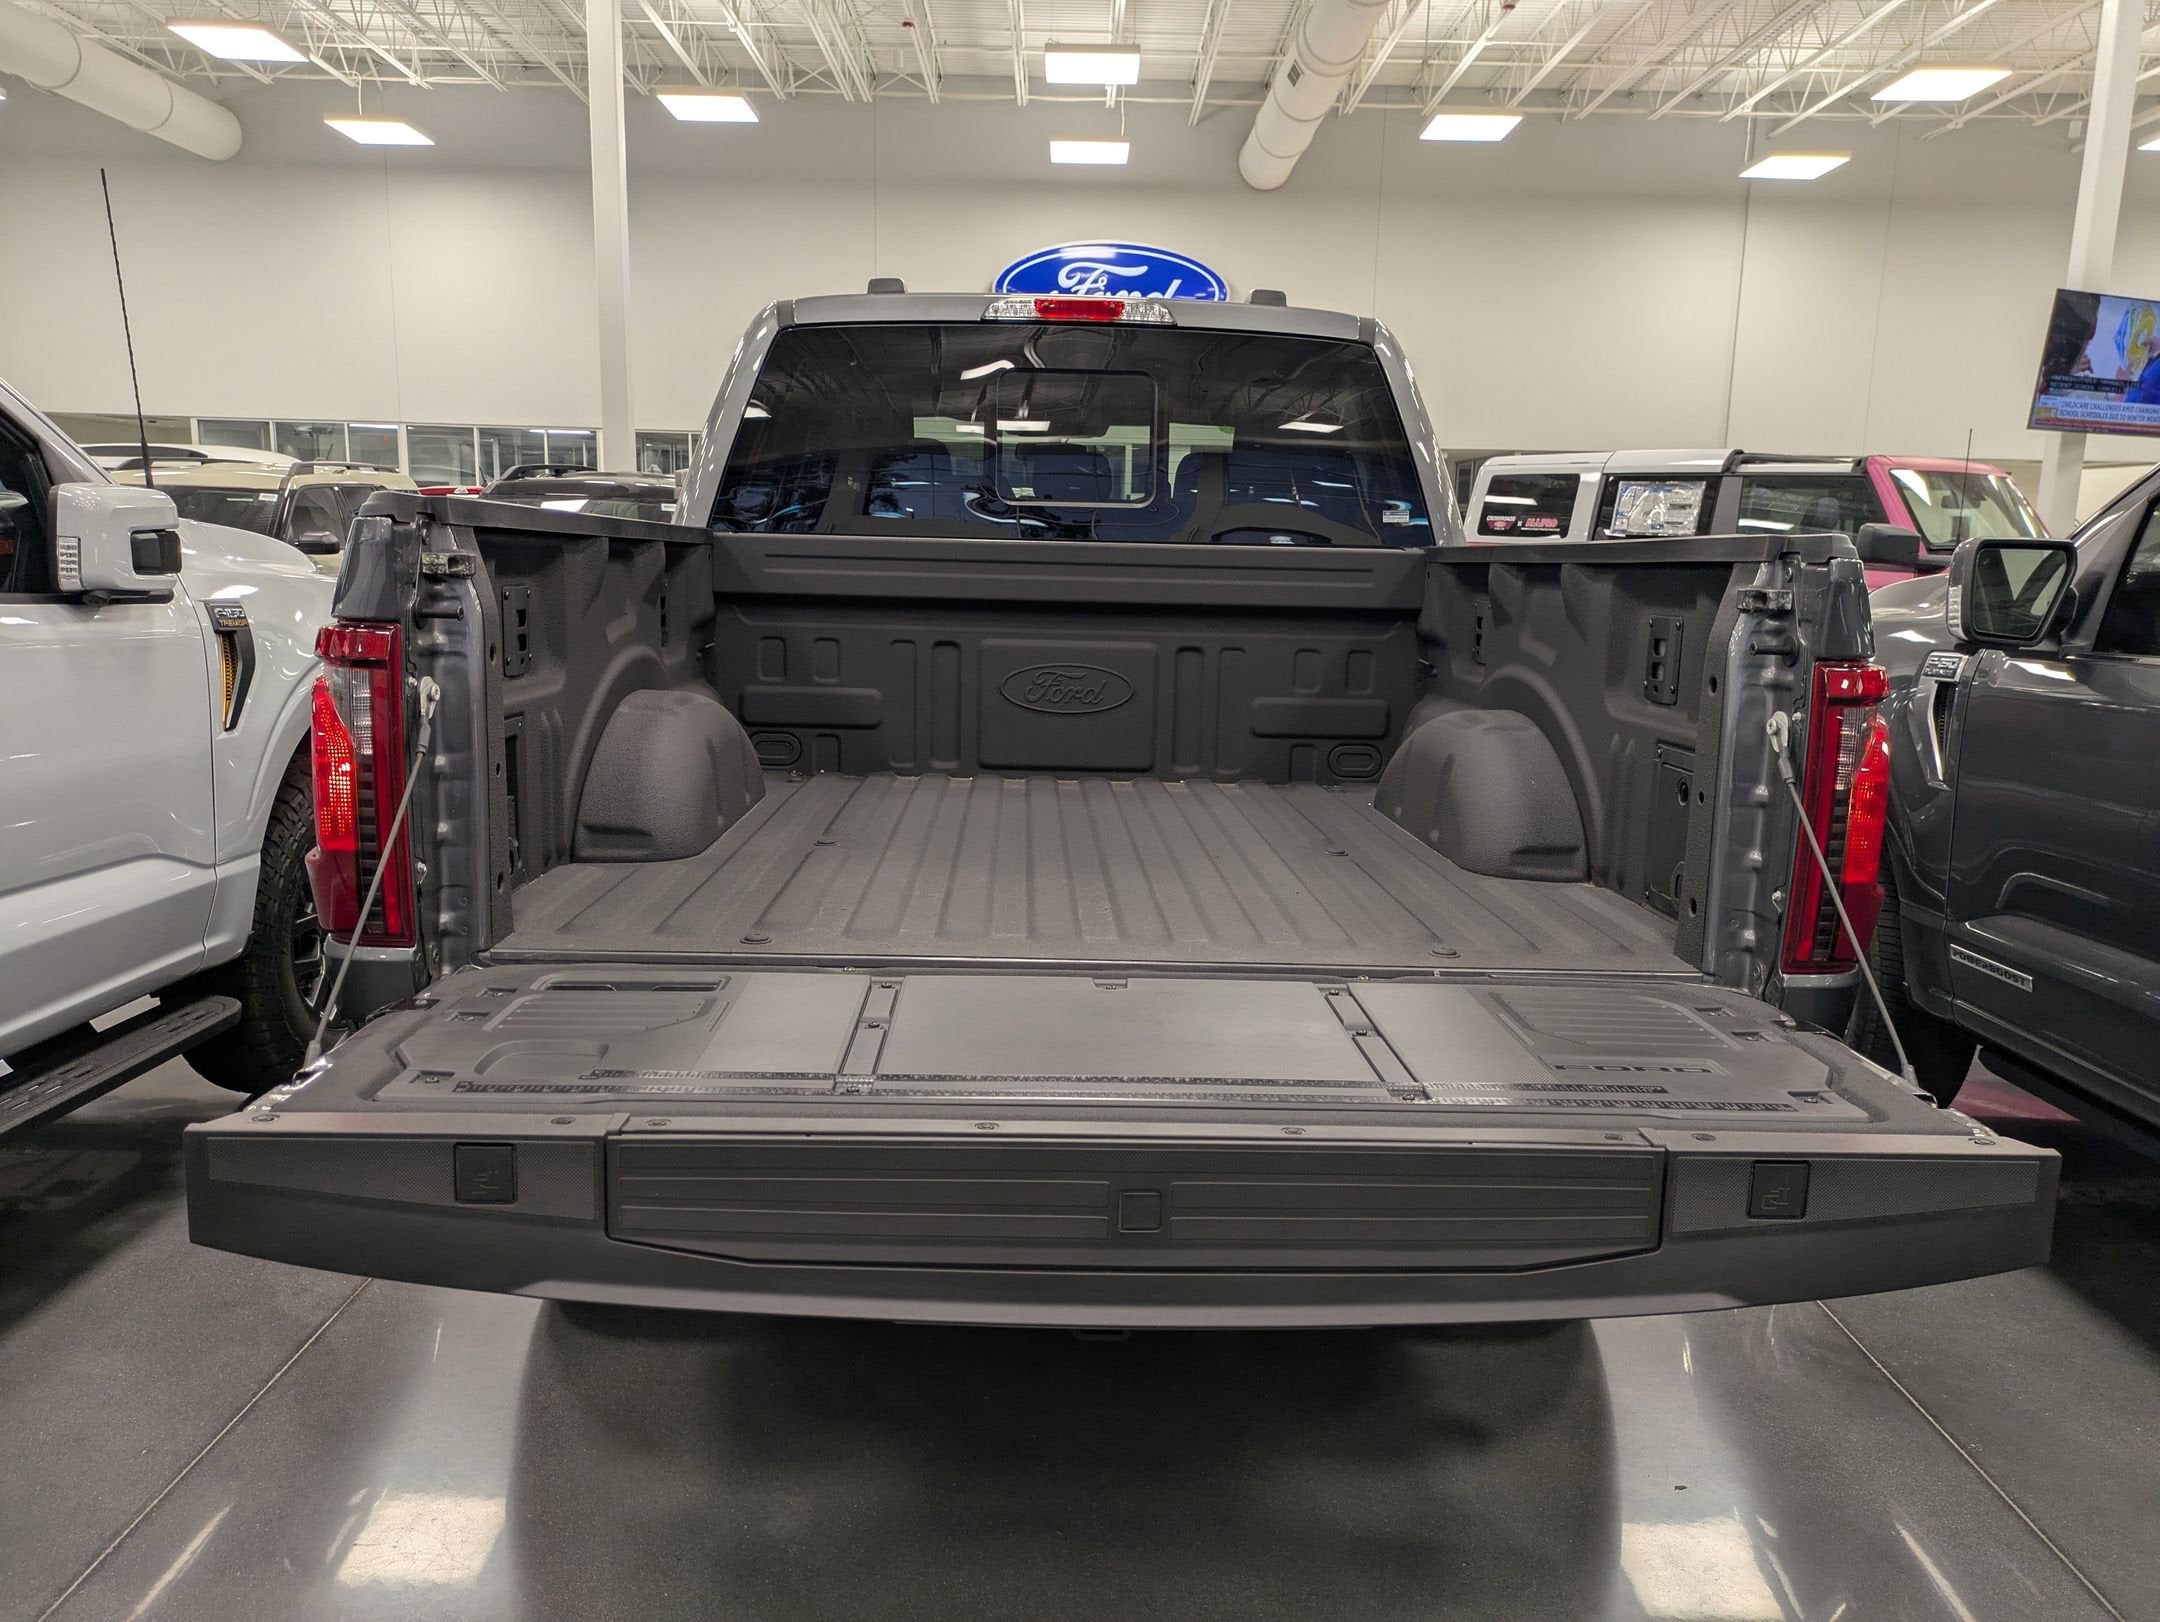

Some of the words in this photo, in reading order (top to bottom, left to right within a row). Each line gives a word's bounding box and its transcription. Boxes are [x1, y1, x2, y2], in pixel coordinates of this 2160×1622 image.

[2061, 400, 2089, 410] CHILDCARE
[2089, 402, 2121, 413] CHALLENGES
[2060, 408, 2079, 418] SCHOOL
[2080, 410, 2109, 420] SCHEDULES
[1525, 517, 1558, 528] ALLPRO
[214, 607, 246, 618] F-150
[219, 619, 249, 628] TREMOR
[1927, 656, 1960, 669] F-150
[1023, 669, 1109, 706] Ford
[1952, 948, 2027, 987] POWERBOOST
